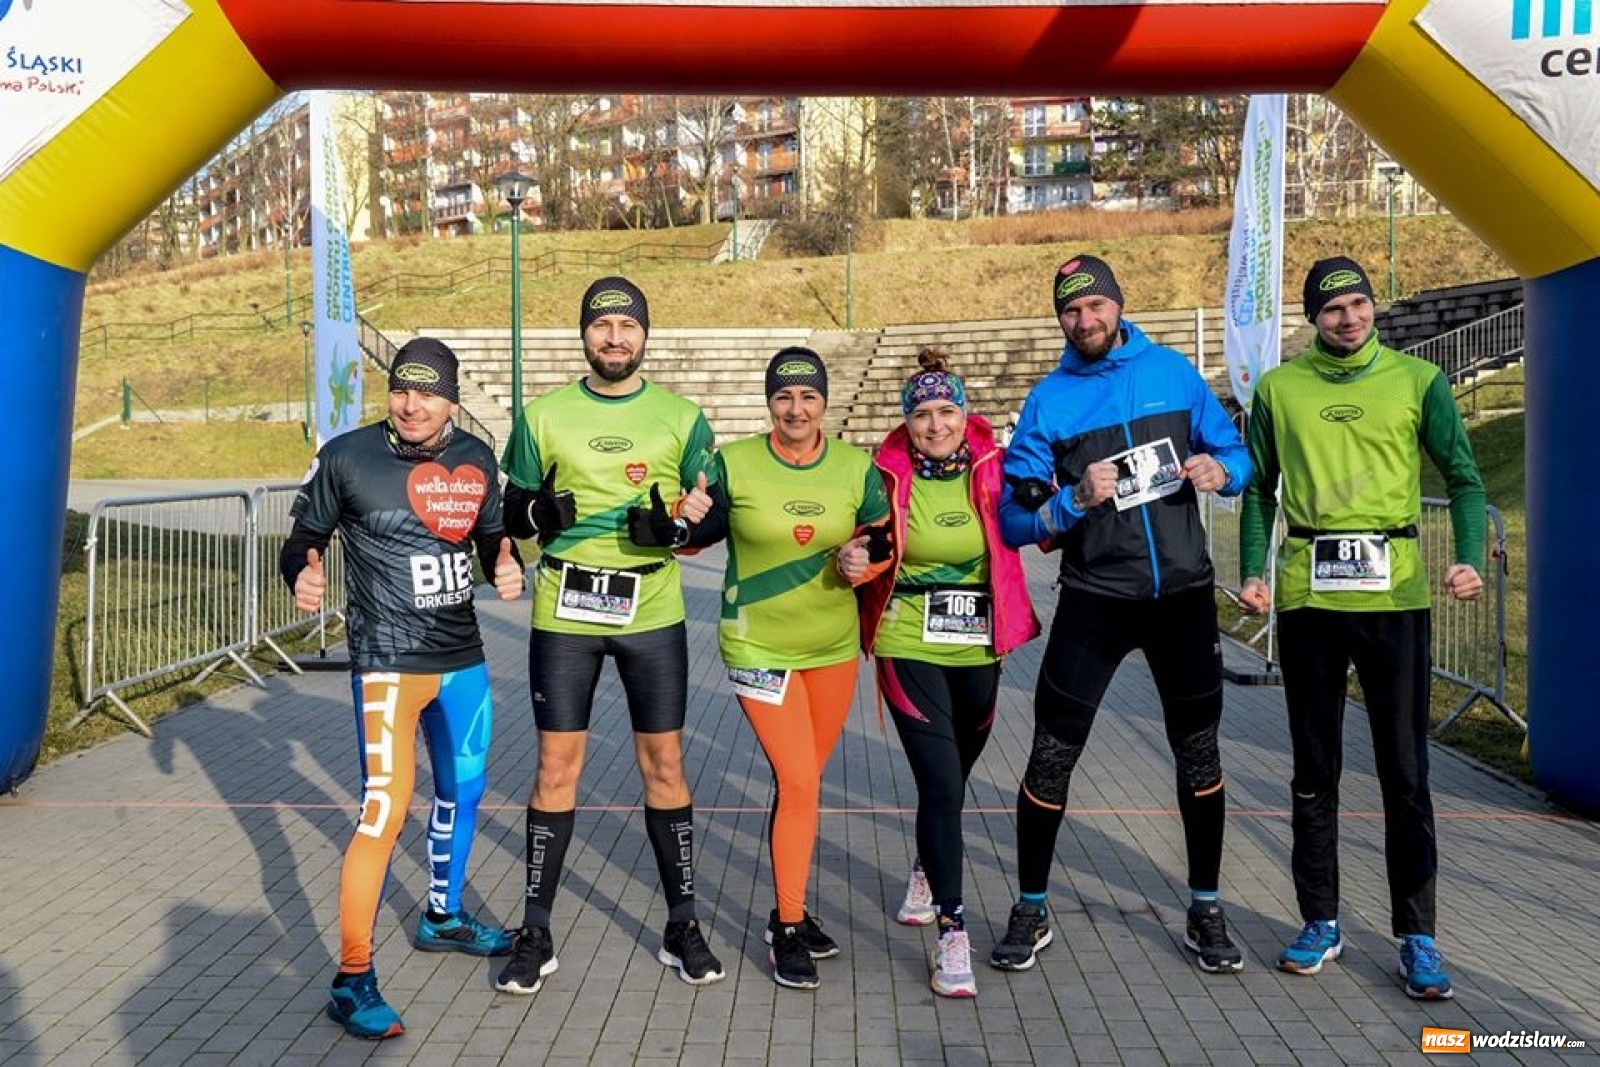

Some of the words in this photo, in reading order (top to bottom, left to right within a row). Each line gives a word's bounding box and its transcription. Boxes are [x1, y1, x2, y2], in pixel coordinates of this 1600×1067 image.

[6, 45, 82, 75] ŚLĄSKI
[1541, 47, 1600, 77] ce
[1338, 540, 1360, 560] 81
[410, 552, 474, 595] BIE
[590, 574, 610, 594] 11
[944, 595, 976, 616] 106
